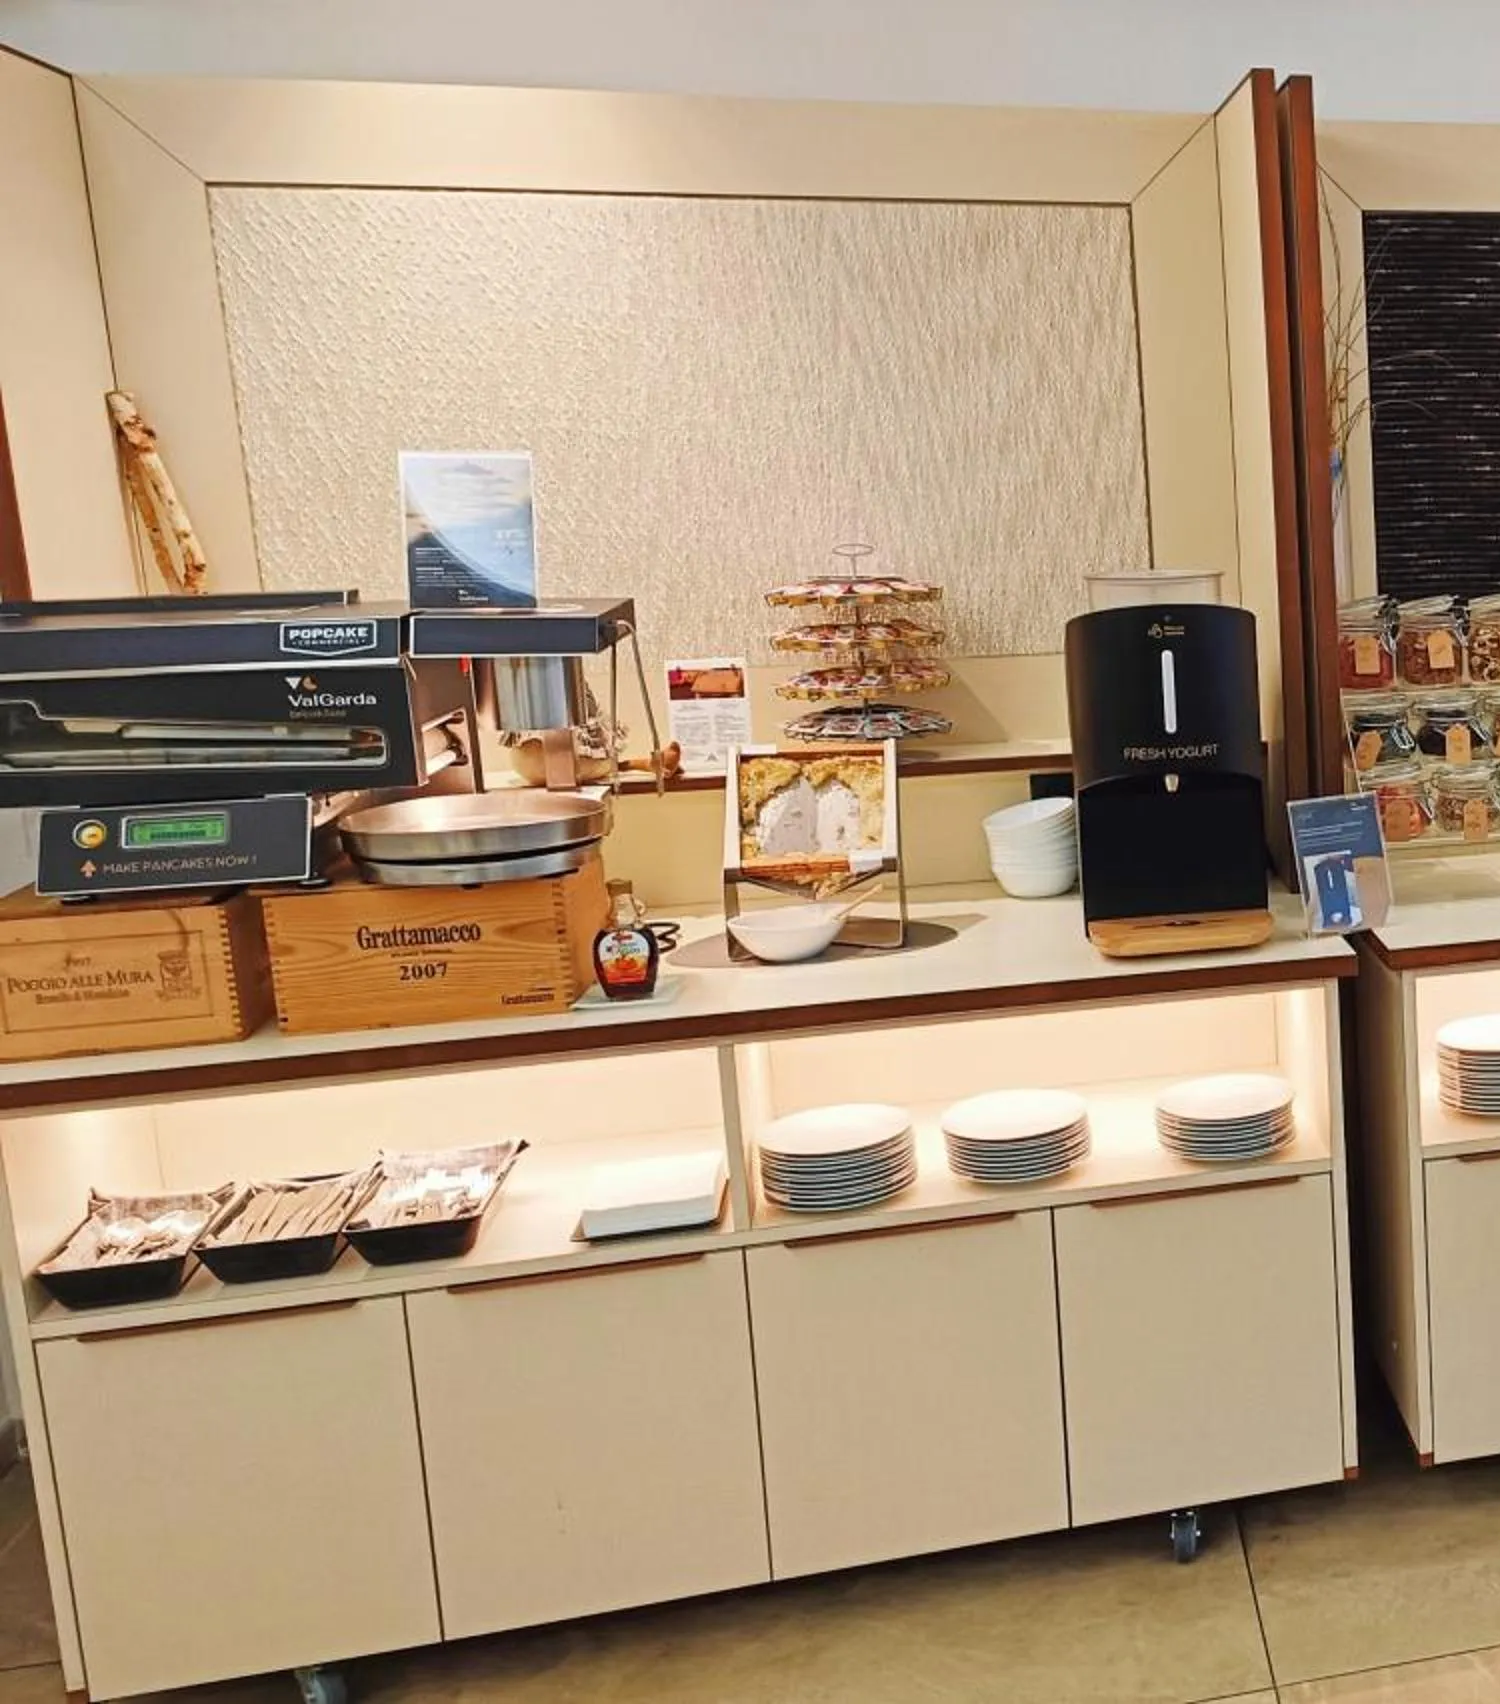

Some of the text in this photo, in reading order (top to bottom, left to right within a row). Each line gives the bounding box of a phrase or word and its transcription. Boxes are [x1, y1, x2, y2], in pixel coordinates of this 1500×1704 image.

[289, 627, 369, 640] POPCAKE
[287, 693, 377, 707] ValGarda
[1123, 743, 1218, 760] FRESH YOGURT
[103, 860, 141, 874] MAKE
[143, 857, 213, 872] PANCAKES
[215, 855, 249, 868] NOW
[356, 923, 481, 949] Grattamacco
[400, 962, 448, 980] 2007
[7, 969, 154, 994] POGGIO ALLE MURA
